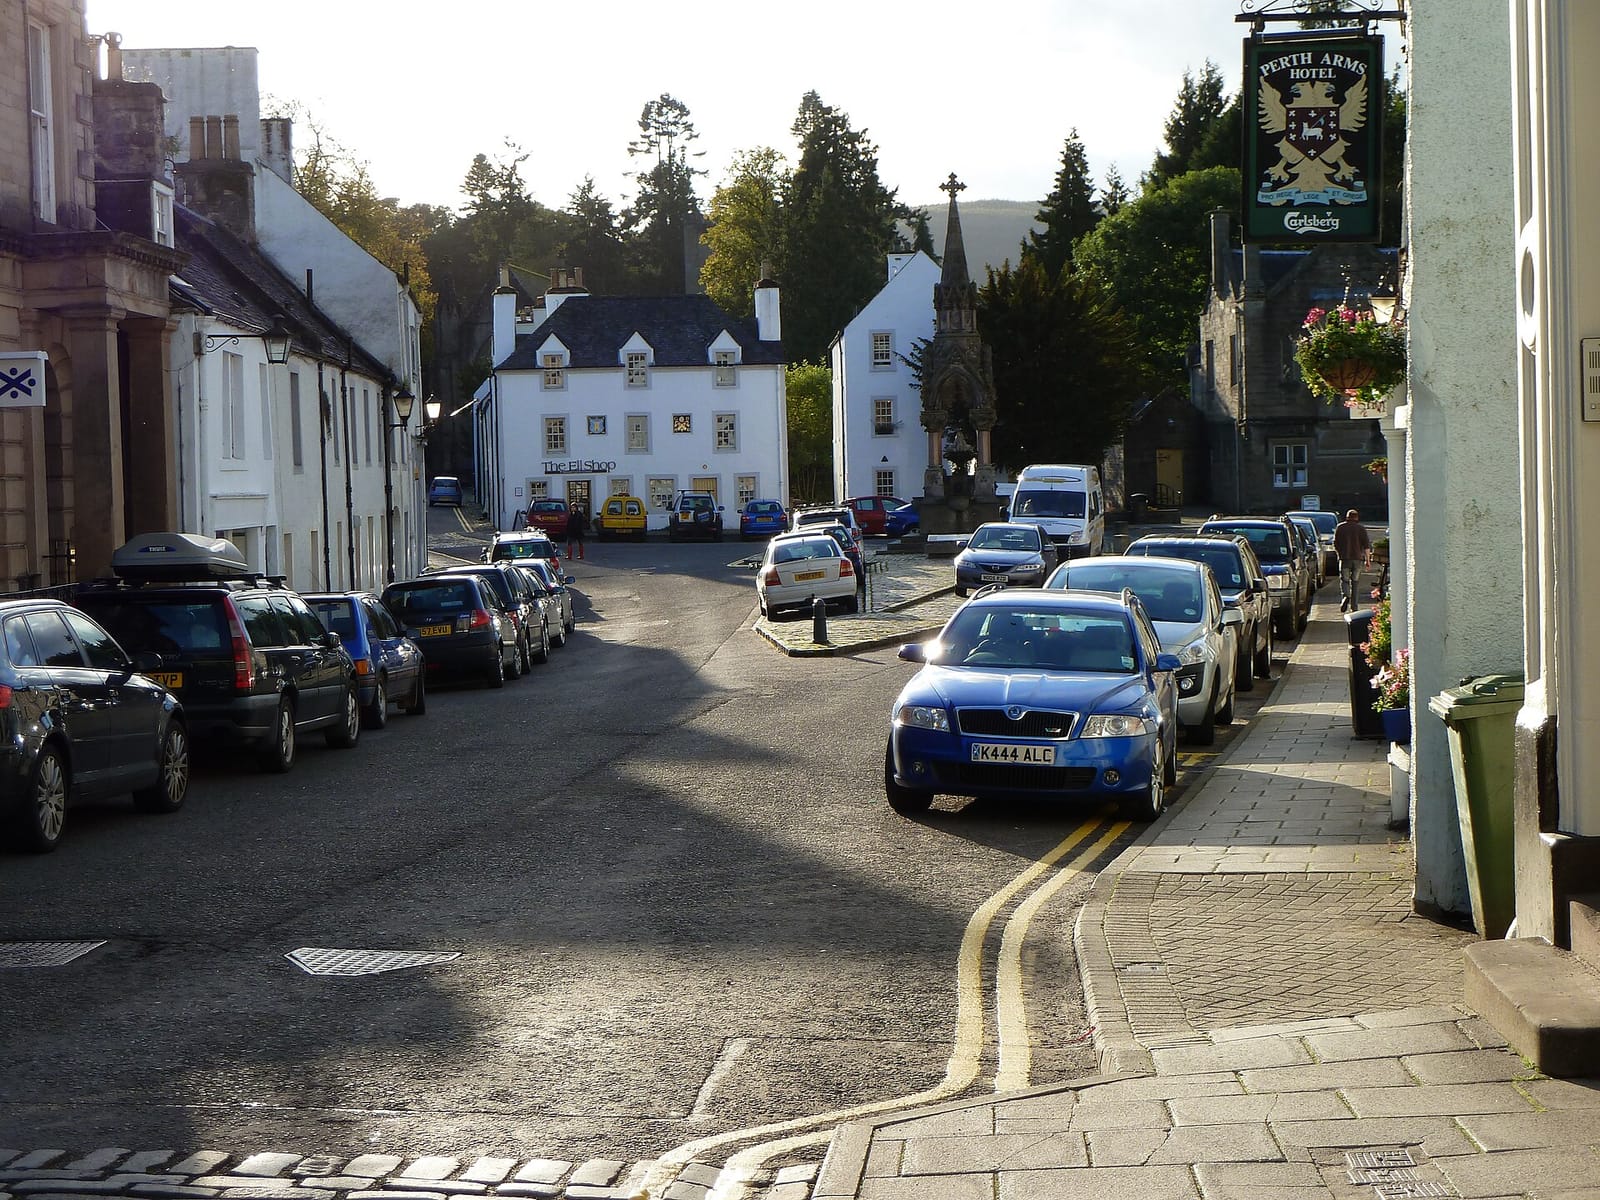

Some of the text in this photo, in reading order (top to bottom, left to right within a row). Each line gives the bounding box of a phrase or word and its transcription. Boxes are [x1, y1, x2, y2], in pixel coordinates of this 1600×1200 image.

[1260, 52, 1367, 77] PERTH ARMS
[1290, 68, 1336, 79] HOTEL
[1284, 212, 1340, 230] Carlsberg
[541, 460, 616, 473] The Ell Shop
[981, 746, 1052, 762] K444 ALC
